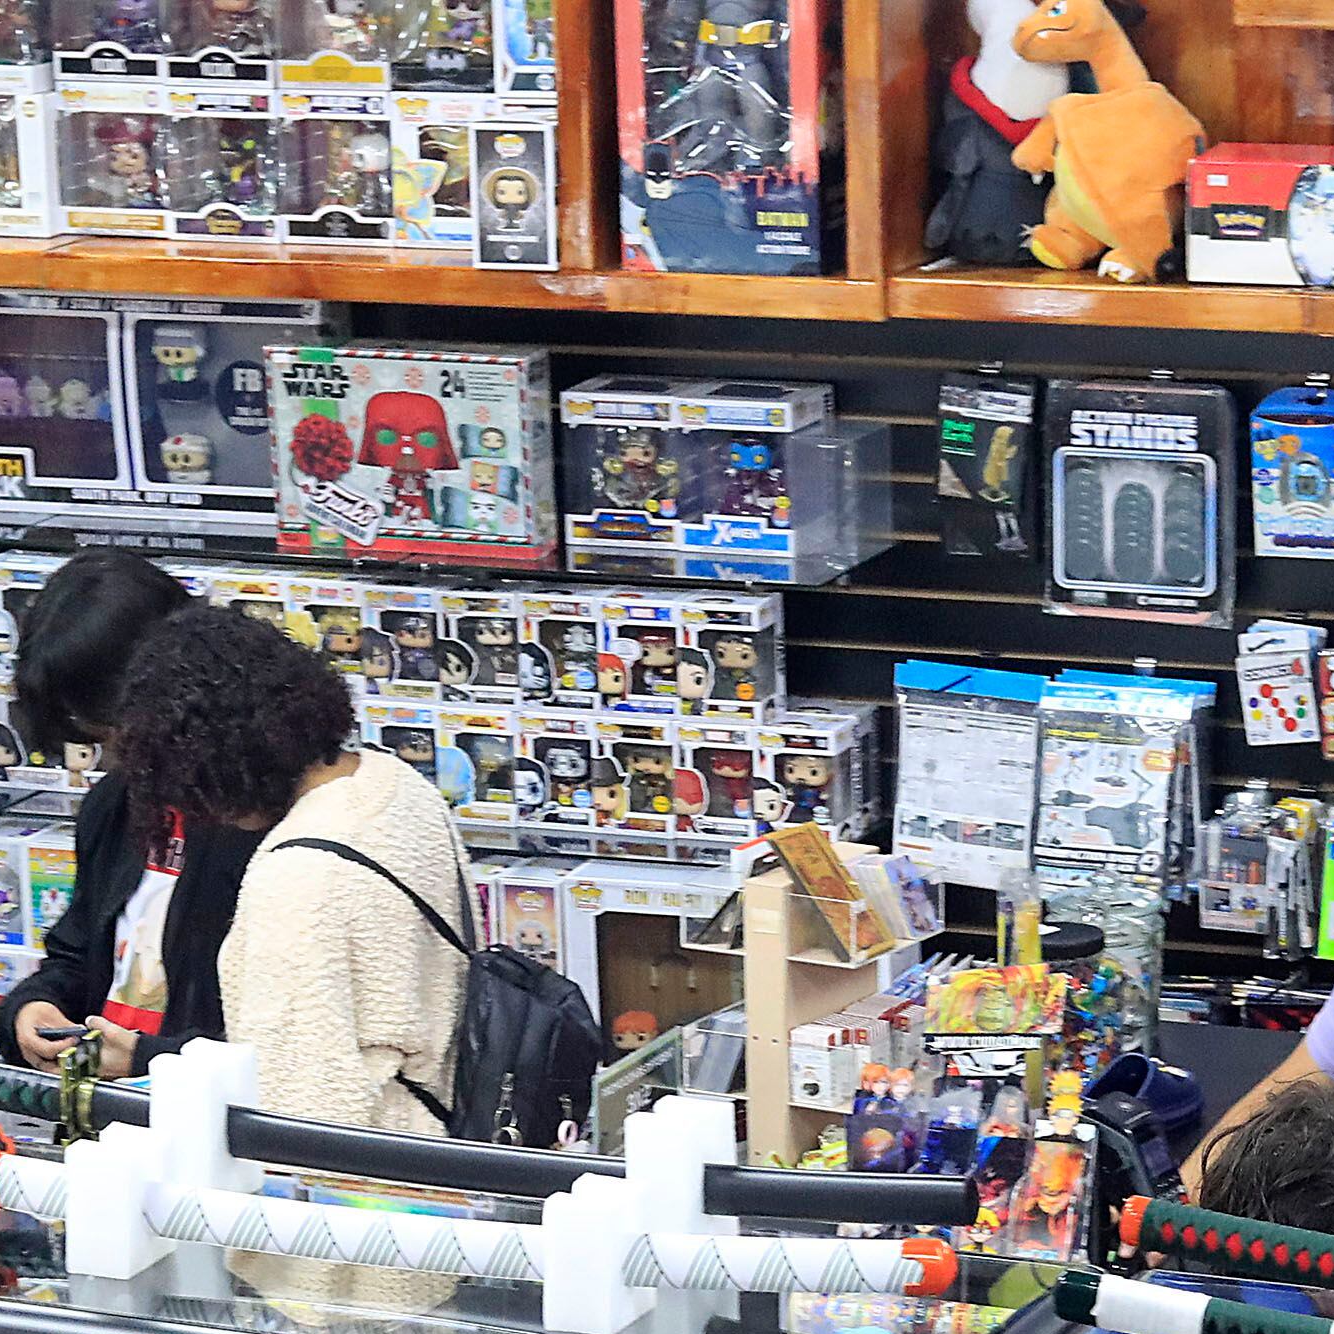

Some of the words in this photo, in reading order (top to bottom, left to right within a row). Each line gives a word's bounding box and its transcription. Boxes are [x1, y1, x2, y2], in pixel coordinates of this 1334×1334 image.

[283, 363, 349, 381] STAR
[283, 380, 349, 400] WARS
[1069, 423, 1198, 451] STANDS
